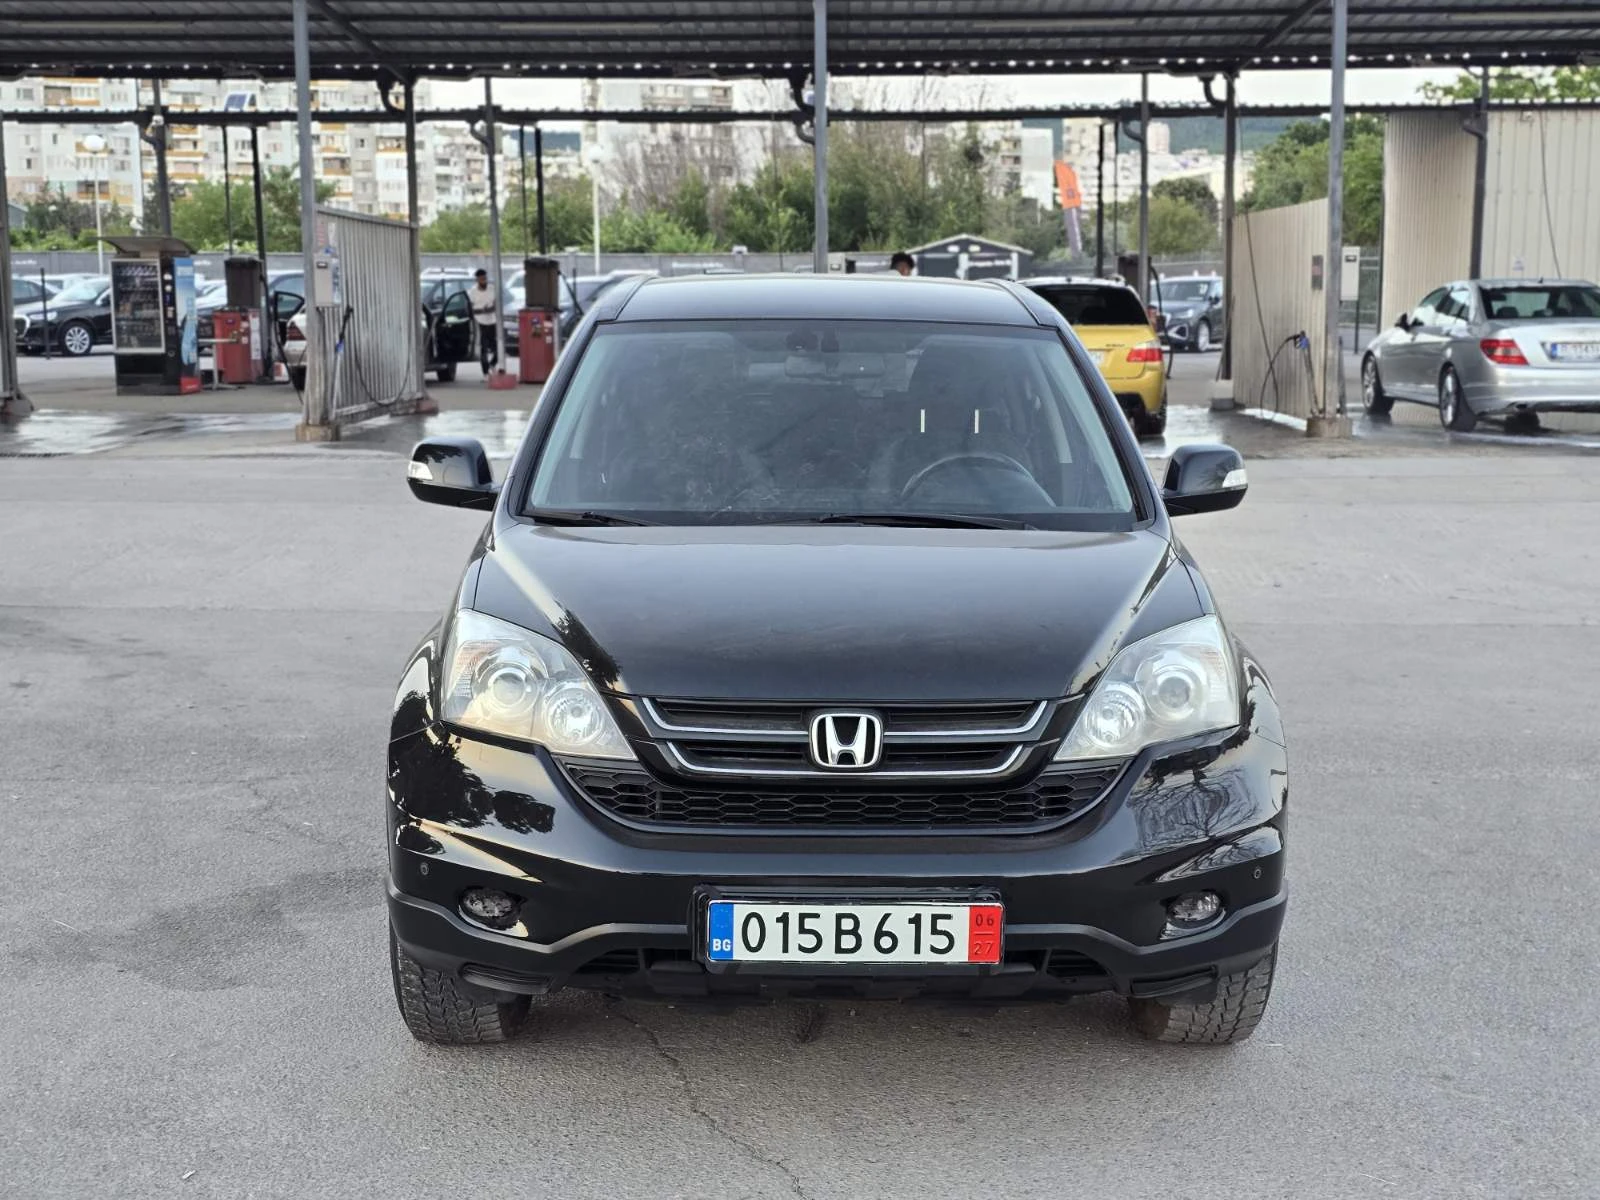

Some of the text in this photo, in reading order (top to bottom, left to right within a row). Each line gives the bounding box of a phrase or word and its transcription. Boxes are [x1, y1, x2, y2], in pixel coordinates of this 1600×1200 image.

[975, 913, 995, 927] 06
[741, 911, 956, 955] 015B615
[712, 938, 731, 952] BG
[974, 941, 994, 956] 27
